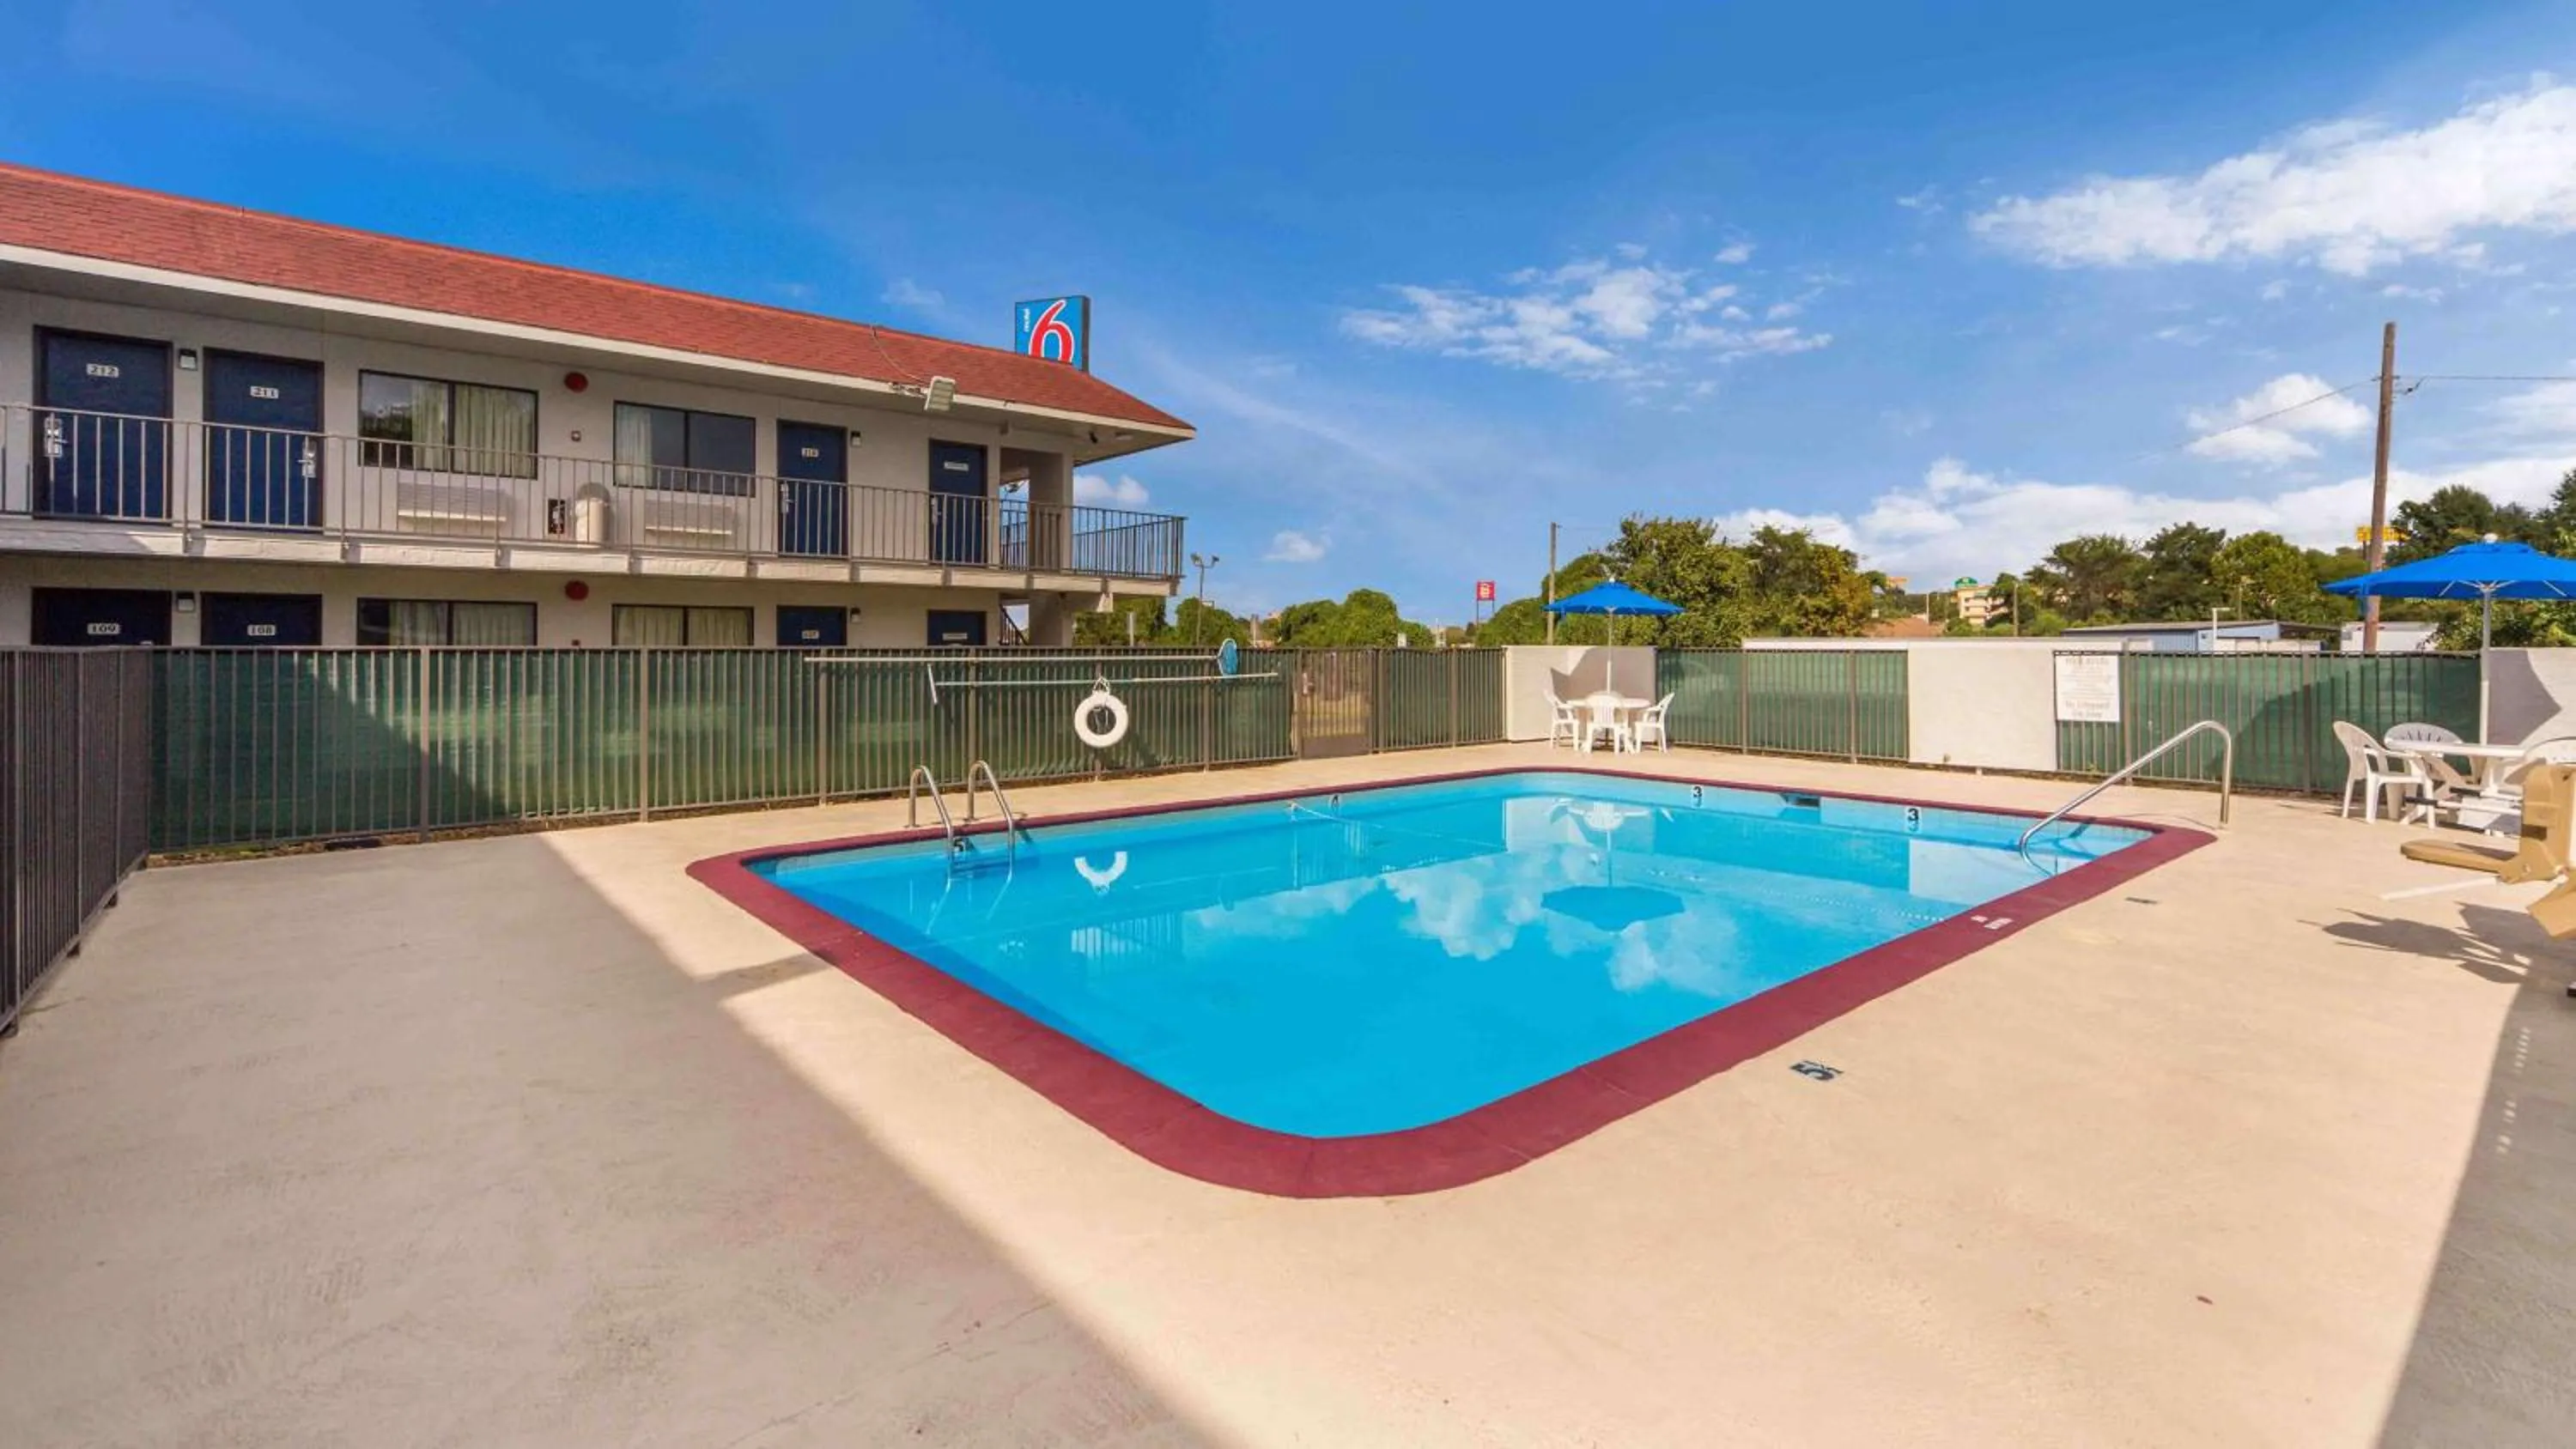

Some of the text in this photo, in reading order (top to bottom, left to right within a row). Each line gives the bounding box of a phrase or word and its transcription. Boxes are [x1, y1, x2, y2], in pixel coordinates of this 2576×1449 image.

[1029, 300, 1074, 363] 6
[88, 364, 117, 376] 212
[92, 624, 117, 634] 109
[1692, 785, 1702, 797] 3
[1907, 808, 1919, 821] 3
